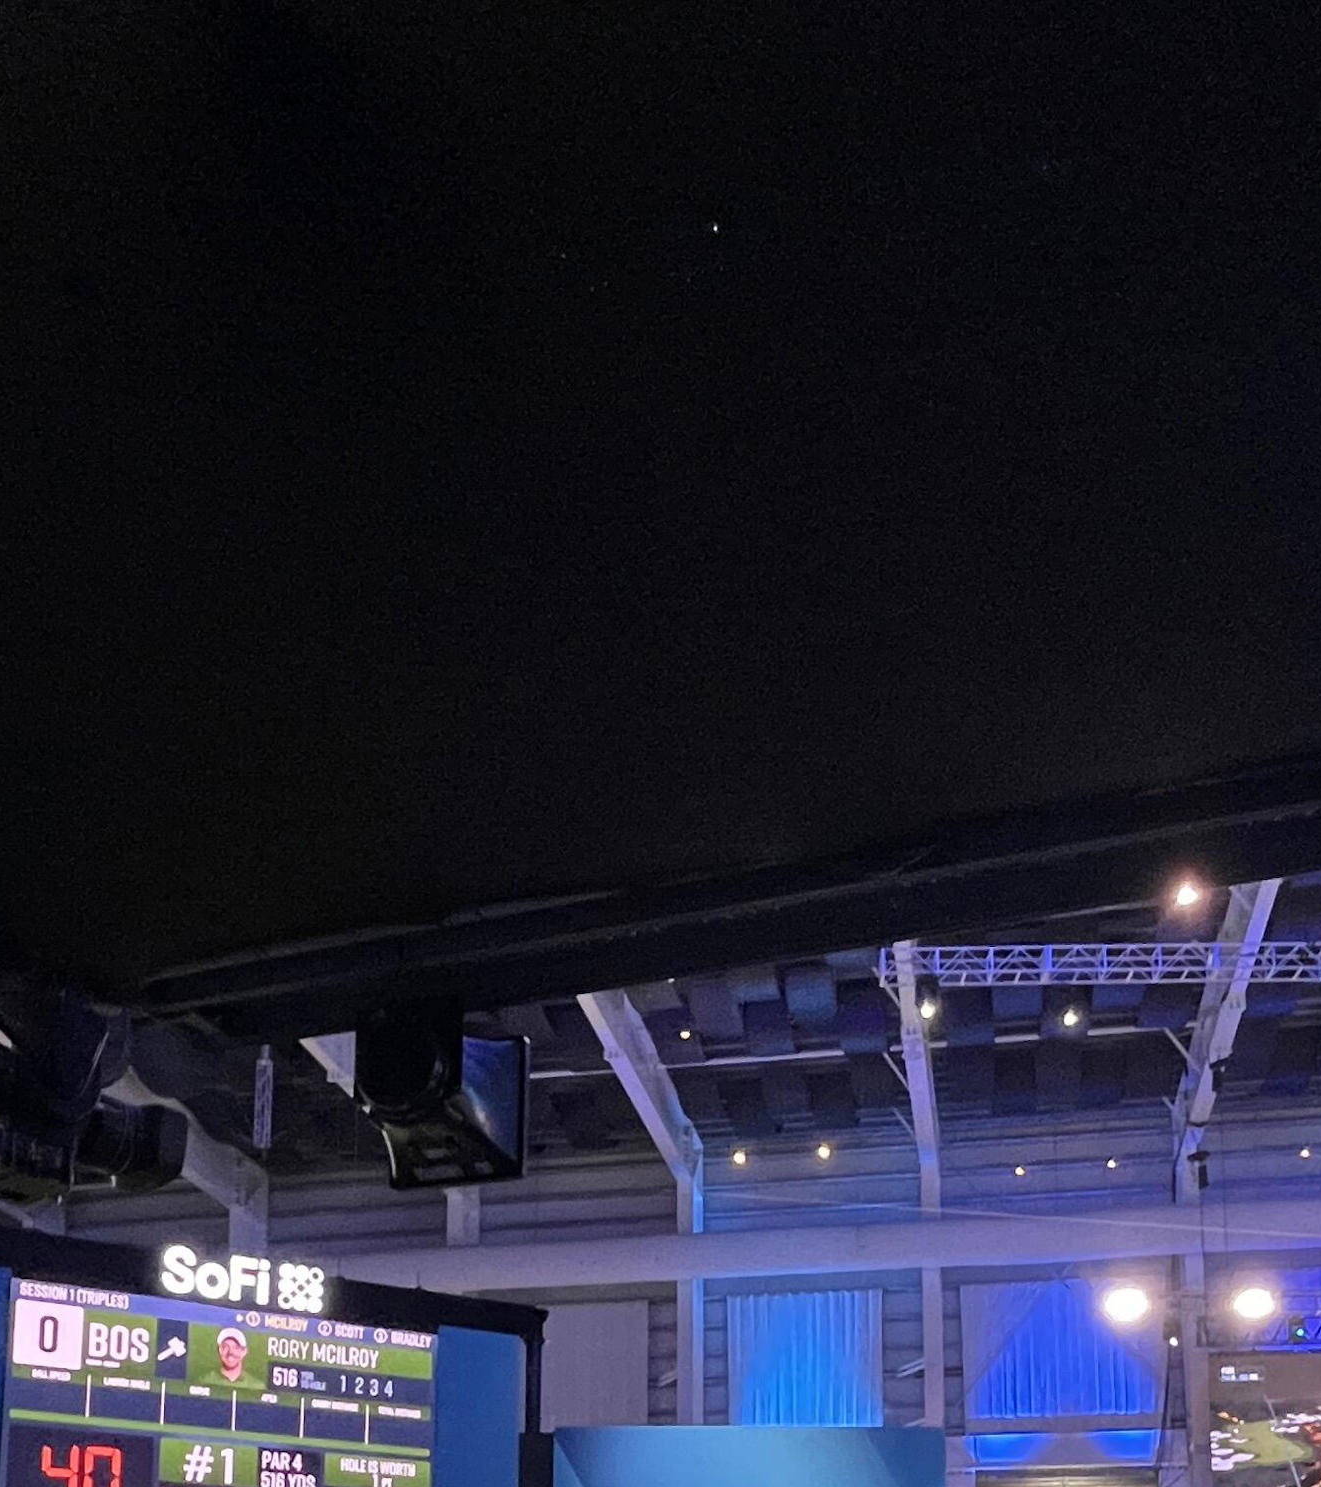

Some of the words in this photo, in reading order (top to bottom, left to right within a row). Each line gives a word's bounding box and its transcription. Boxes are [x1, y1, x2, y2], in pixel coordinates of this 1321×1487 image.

[161, 1245, 271, 1306] SoFi
[19, 1282, 68, 1301] SESSION
[69, 1288, 75, 1301] 1
[77, 1289, 129, 1310] (TRIPLES)
[39, 1316, 59, 1353] 0
[88, 1322, 150, 1363] BOS
[265, 1315, 308, 1331] MCILROY
[335, 1324, 364, 1339] SCOTT
[390, 1331, 432, 1348] BRADLEY
[267, 1336, 309, 1361] RORY
[312, 1343, 379, 1368] MCILROY
[272, 1366, 298, 1387] 516
[340, 1375, 346, 1392] 1
[354, 1377, 364, 1395] 2
[369, 1379, 379, 1396] 3
[384, 1381, 394, 1398] 4
[261, 1450, 290, 1471] PAR
[291, 1453, 303, 1471] 4
[340, 1457, 366, 1473] HOLE
[368, 1460, 378, 1474] IS
[379, 1461, 416, 1477] WORTH
